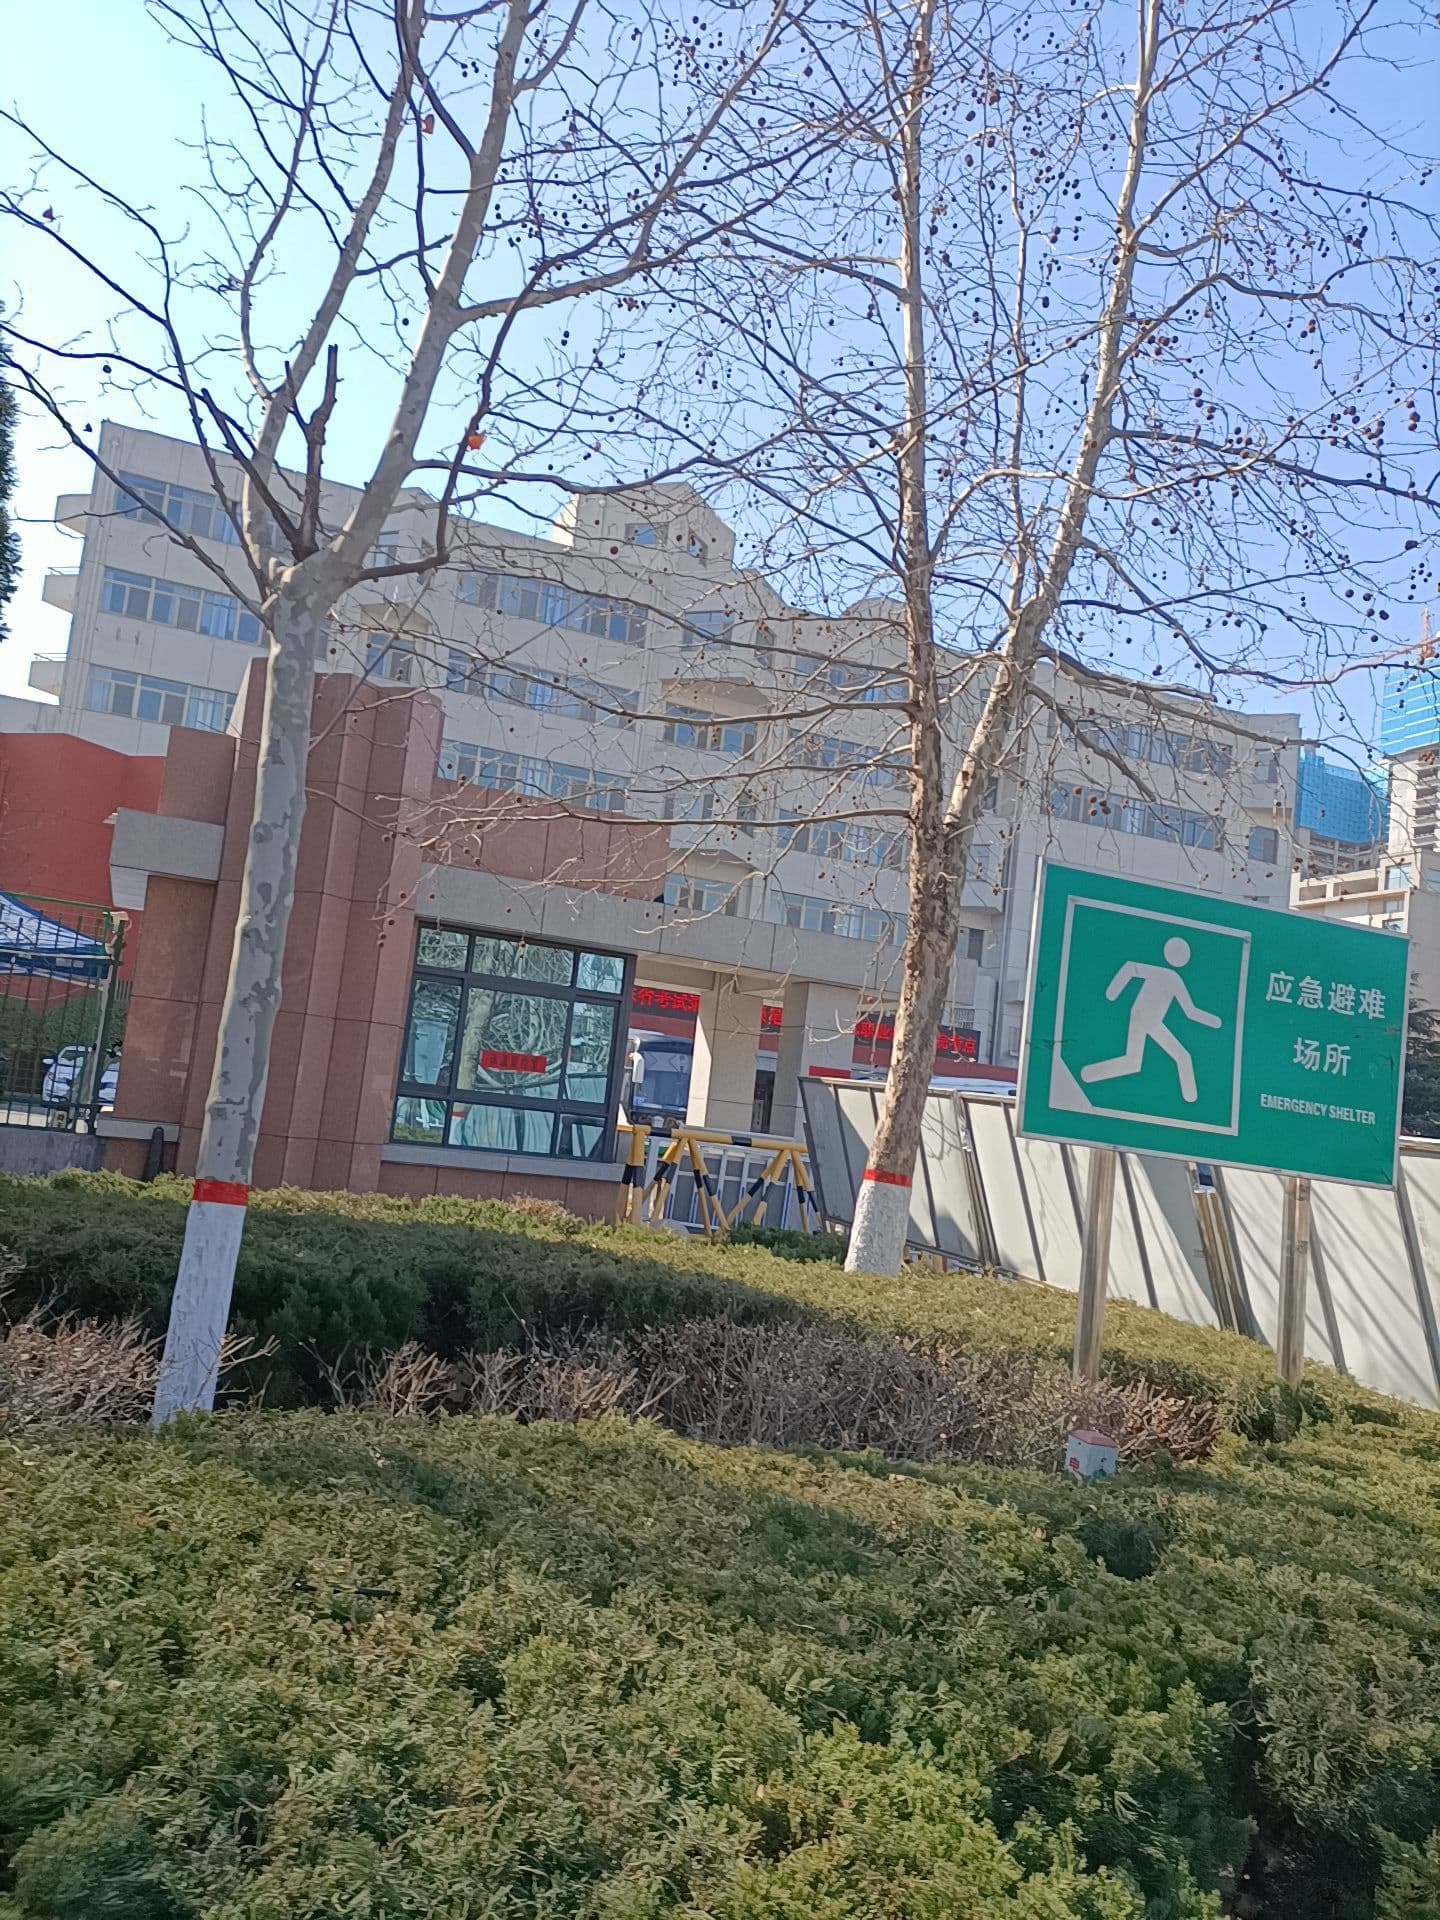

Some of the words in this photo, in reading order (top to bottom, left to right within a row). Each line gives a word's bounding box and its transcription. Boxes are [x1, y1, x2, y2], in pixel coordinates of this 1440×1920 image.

[1265, 971, 1386, 1020] 应急避难
[1293, 1037, 1352, 1077] 场所
[1260, 1093, 1328, 1117] EMERGENCY
[1328, 1105, 1376, 1125] SHELTER
